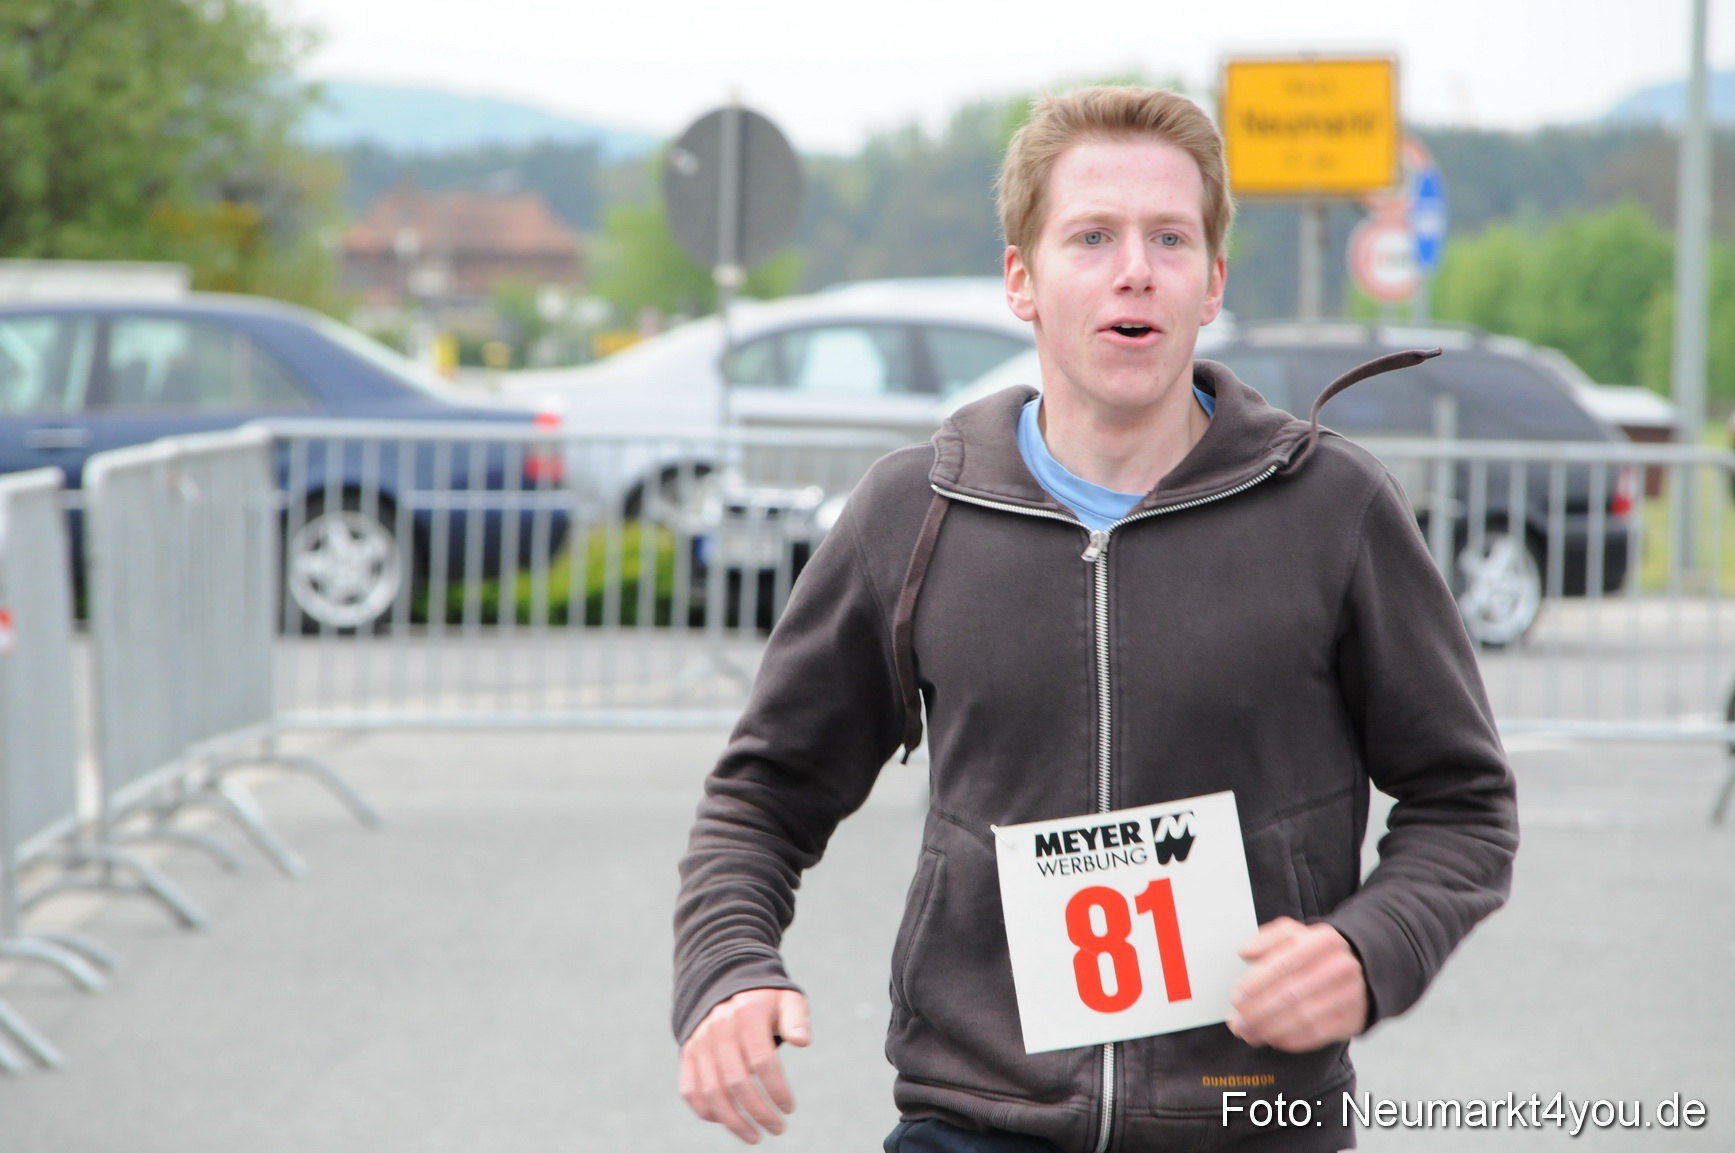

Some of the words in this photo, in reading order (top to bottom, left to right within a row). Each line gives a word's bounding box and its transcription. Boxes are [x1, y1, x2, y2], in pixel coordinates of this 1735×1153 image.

[1035, 821, 1144, 858] MEYER
[1036, 846, 1149, 877] WERBUNG
[1065, 877, 1193, 1014] 81
